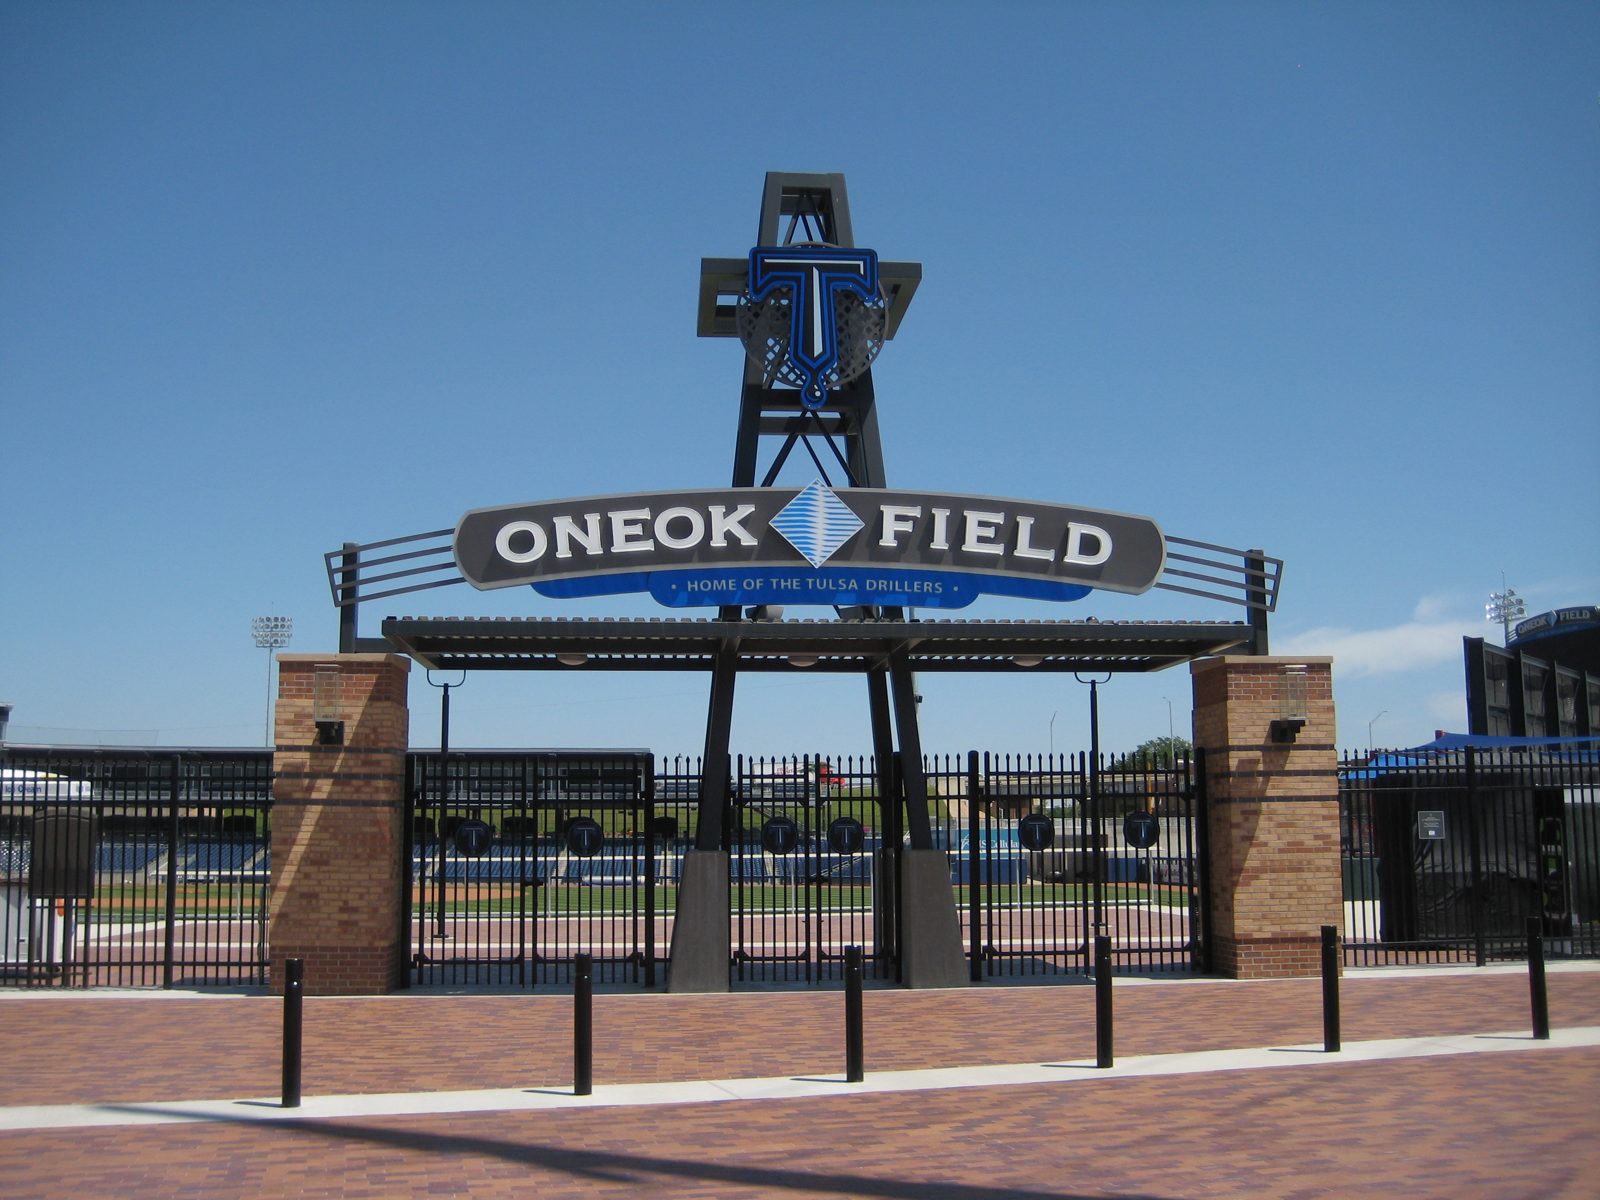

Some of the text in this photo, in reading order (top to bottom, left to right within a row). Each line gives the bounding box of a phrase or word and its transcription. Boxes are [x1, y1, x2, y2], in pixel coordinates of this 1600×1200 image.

[495, 504, 1113, 566] ONEOK FIELD
[686, 578, 943, 593] HOME OF THE TULSA DRILLERS
[1517, 609, 1590, 634] ONEOK FIELD
